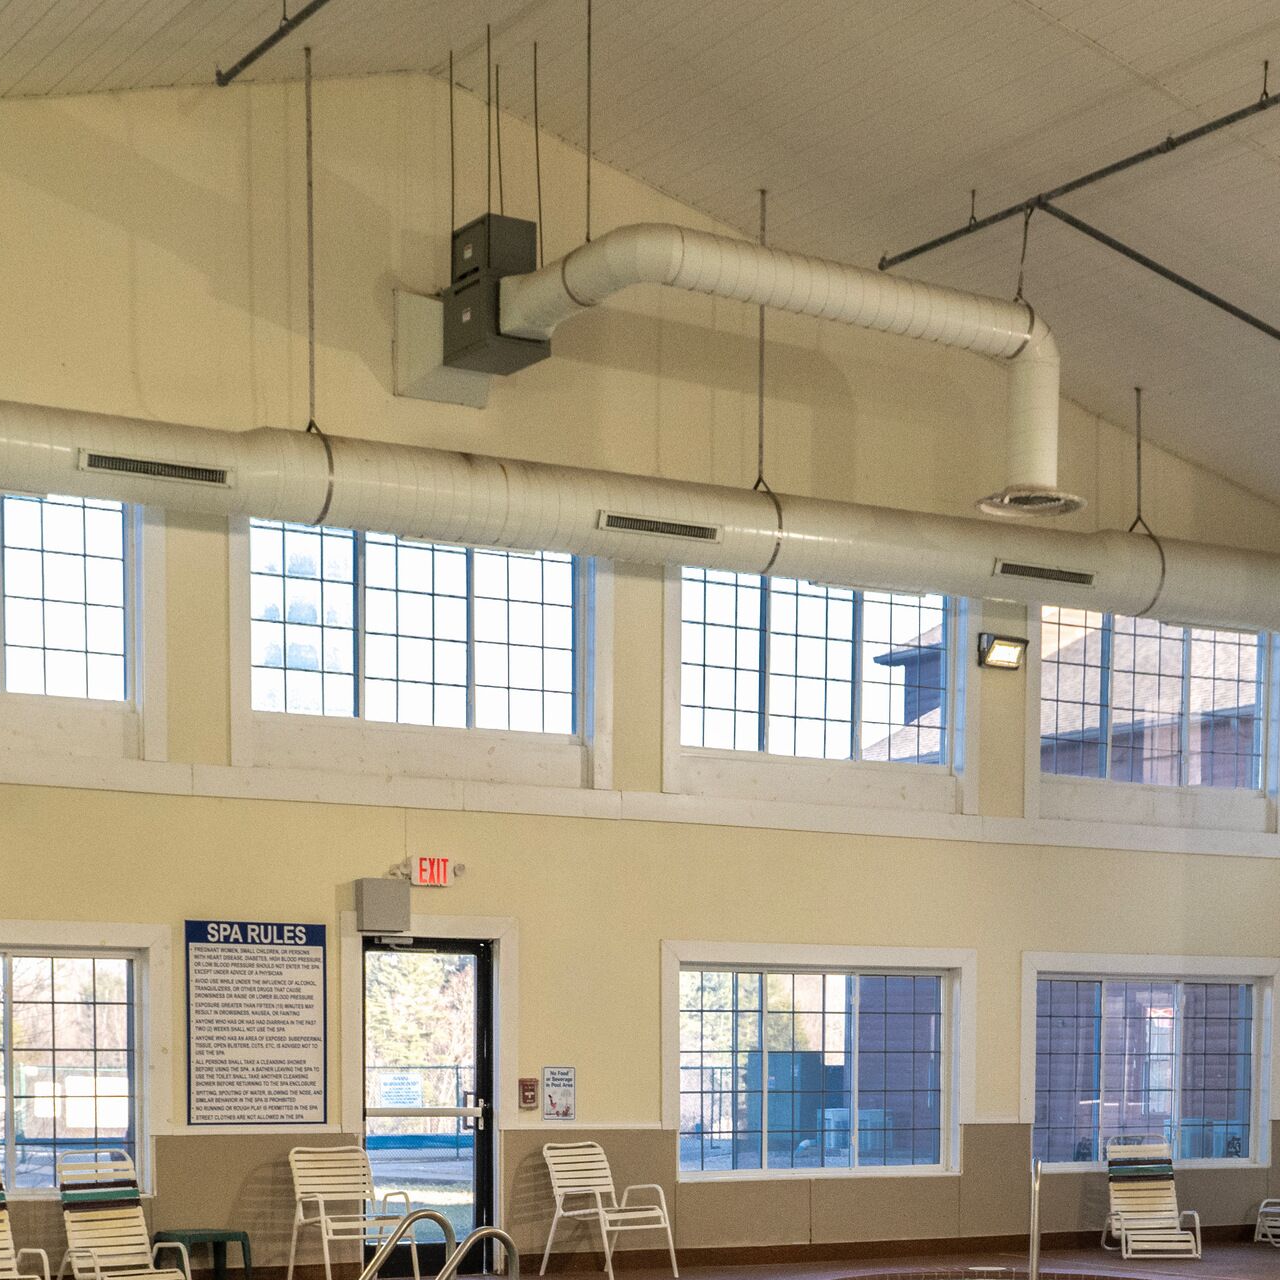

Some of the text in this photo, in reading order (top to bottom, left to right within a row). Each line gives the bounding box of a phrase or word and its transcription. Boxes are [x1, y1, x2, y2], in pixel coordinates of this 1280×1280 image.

[418, 857, 449, 884] EXIT
[207, 923, 307, 945] SPA RULES
